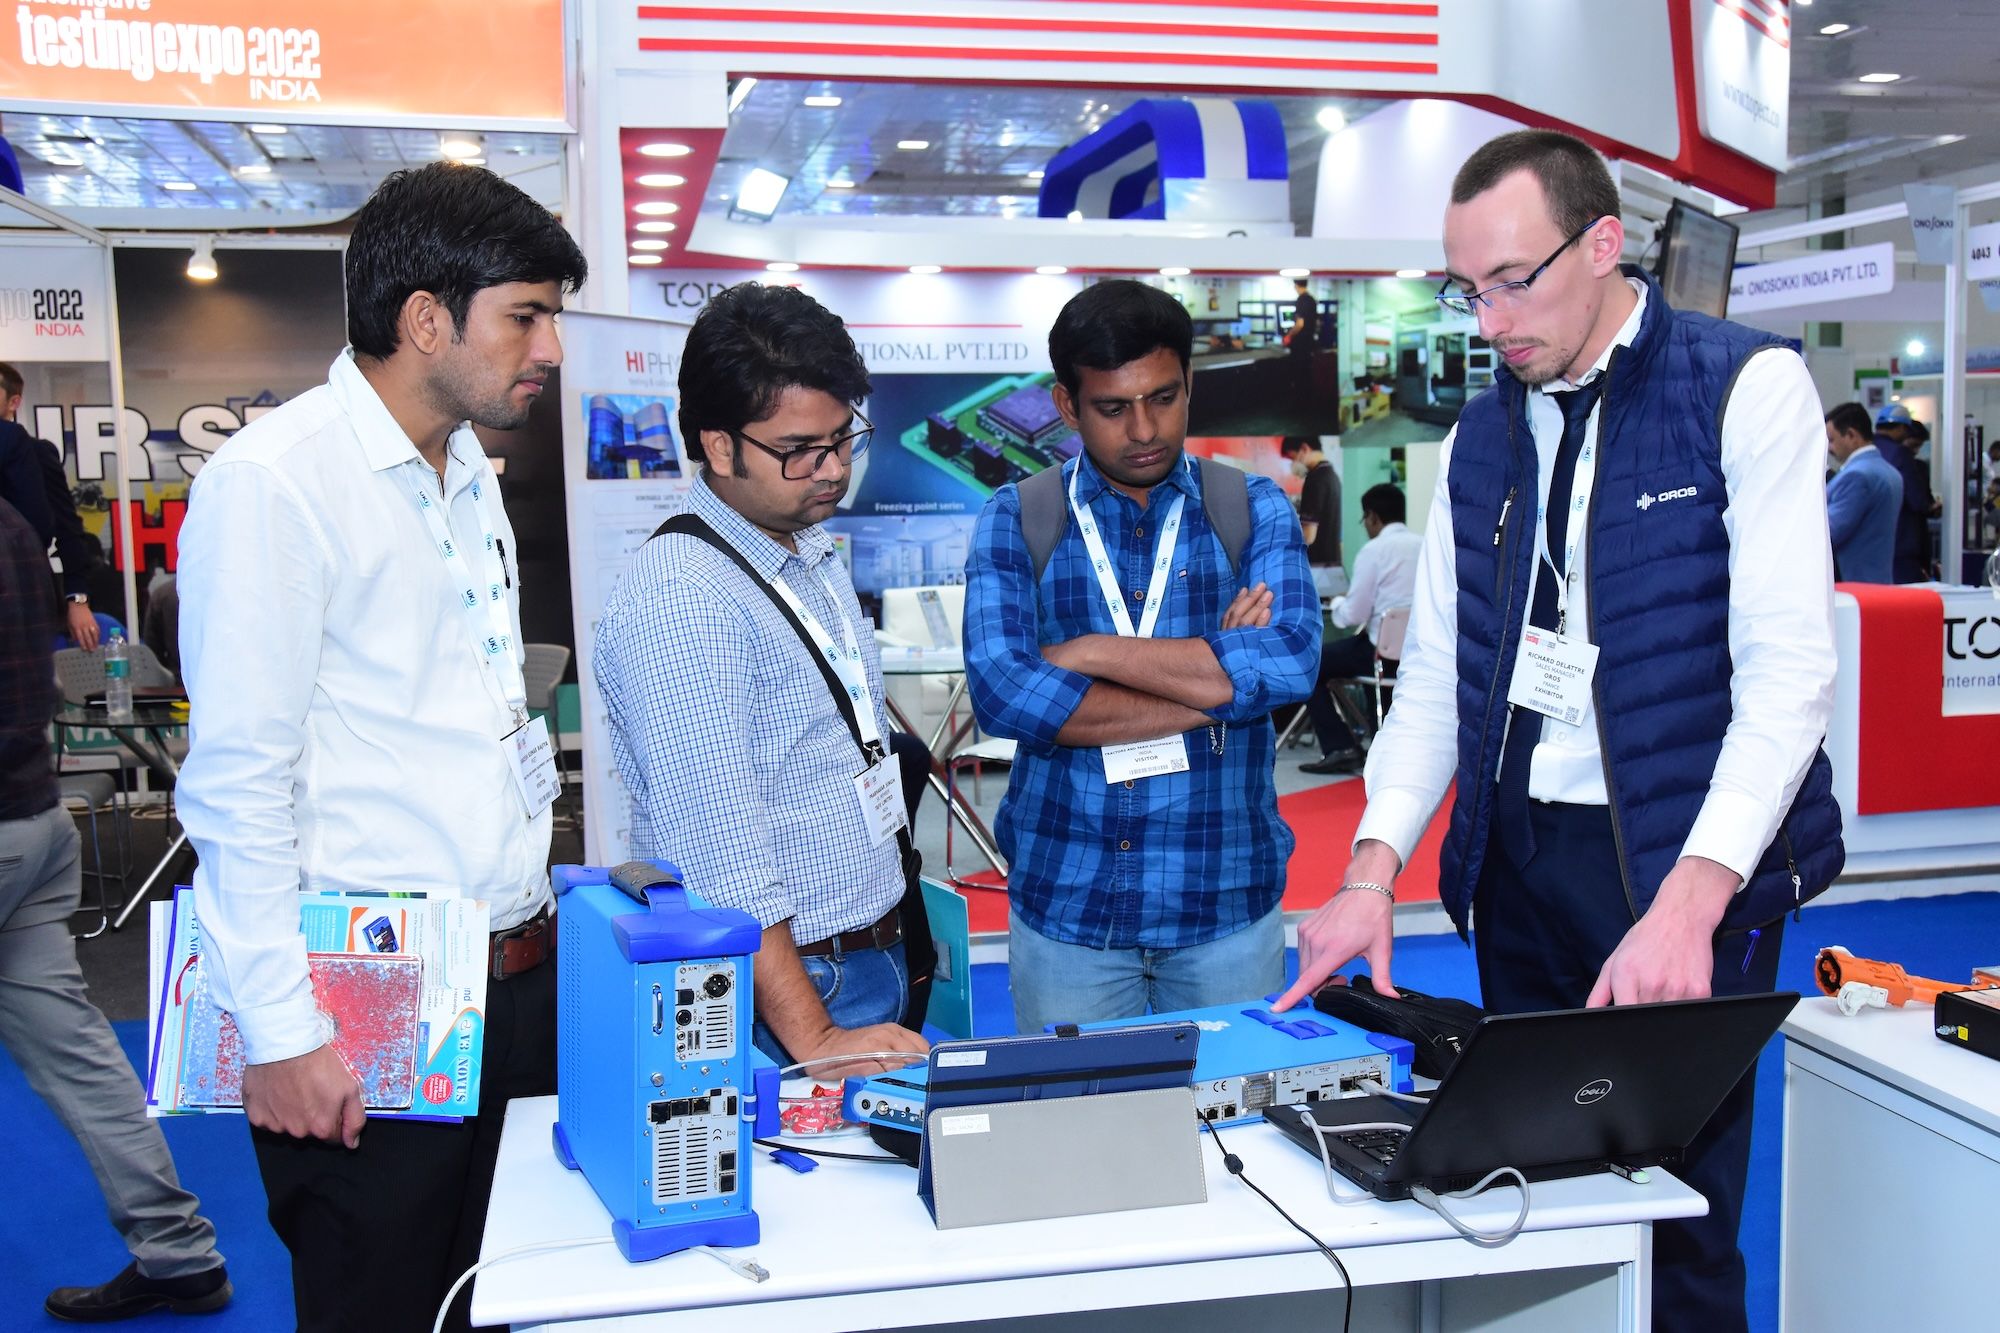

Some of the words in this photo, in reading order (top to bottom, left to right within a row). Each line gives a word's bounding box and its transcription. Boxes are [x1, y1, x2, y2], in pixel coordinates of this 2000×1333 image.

[248, 27, 321, 78] 2022
[250, 78, 321, 102] INDIA
[1748, 274, 1799, 296] ONOSOKKI
[1802, 270, 1830, 288] INDIA
[1857, 261, 1880, 281] LTD.
[33, 289, 84, 320] 2022
[35, 323, 85, 336] INDIA
[625, 350, 644, 373] HI
[1658, 486, 1697, 502] OROS
[875, 502, 913, 513] Freezing
[914, 502, 938, 512] point
[940, 503, 965, 511] series
[1528, 651, 1554, 665] RICHARD
[1556, 660, 1585, 675] DELATTRE
[1536, 662, 1551, 671] SALES
[1552, 666, 1575, 679] MANAGER
[1544, 672, 1561, 683] OROS
[1534, 686, 1563, 700] EXHIBITOR
[1543, 681, 1560, 691] FRANCE
[1134, 755, 1159, 763] VISITOR
[456, 1058, 470, 1103] NOVUS
[1580, 1088, 1605, 1096] DELL
